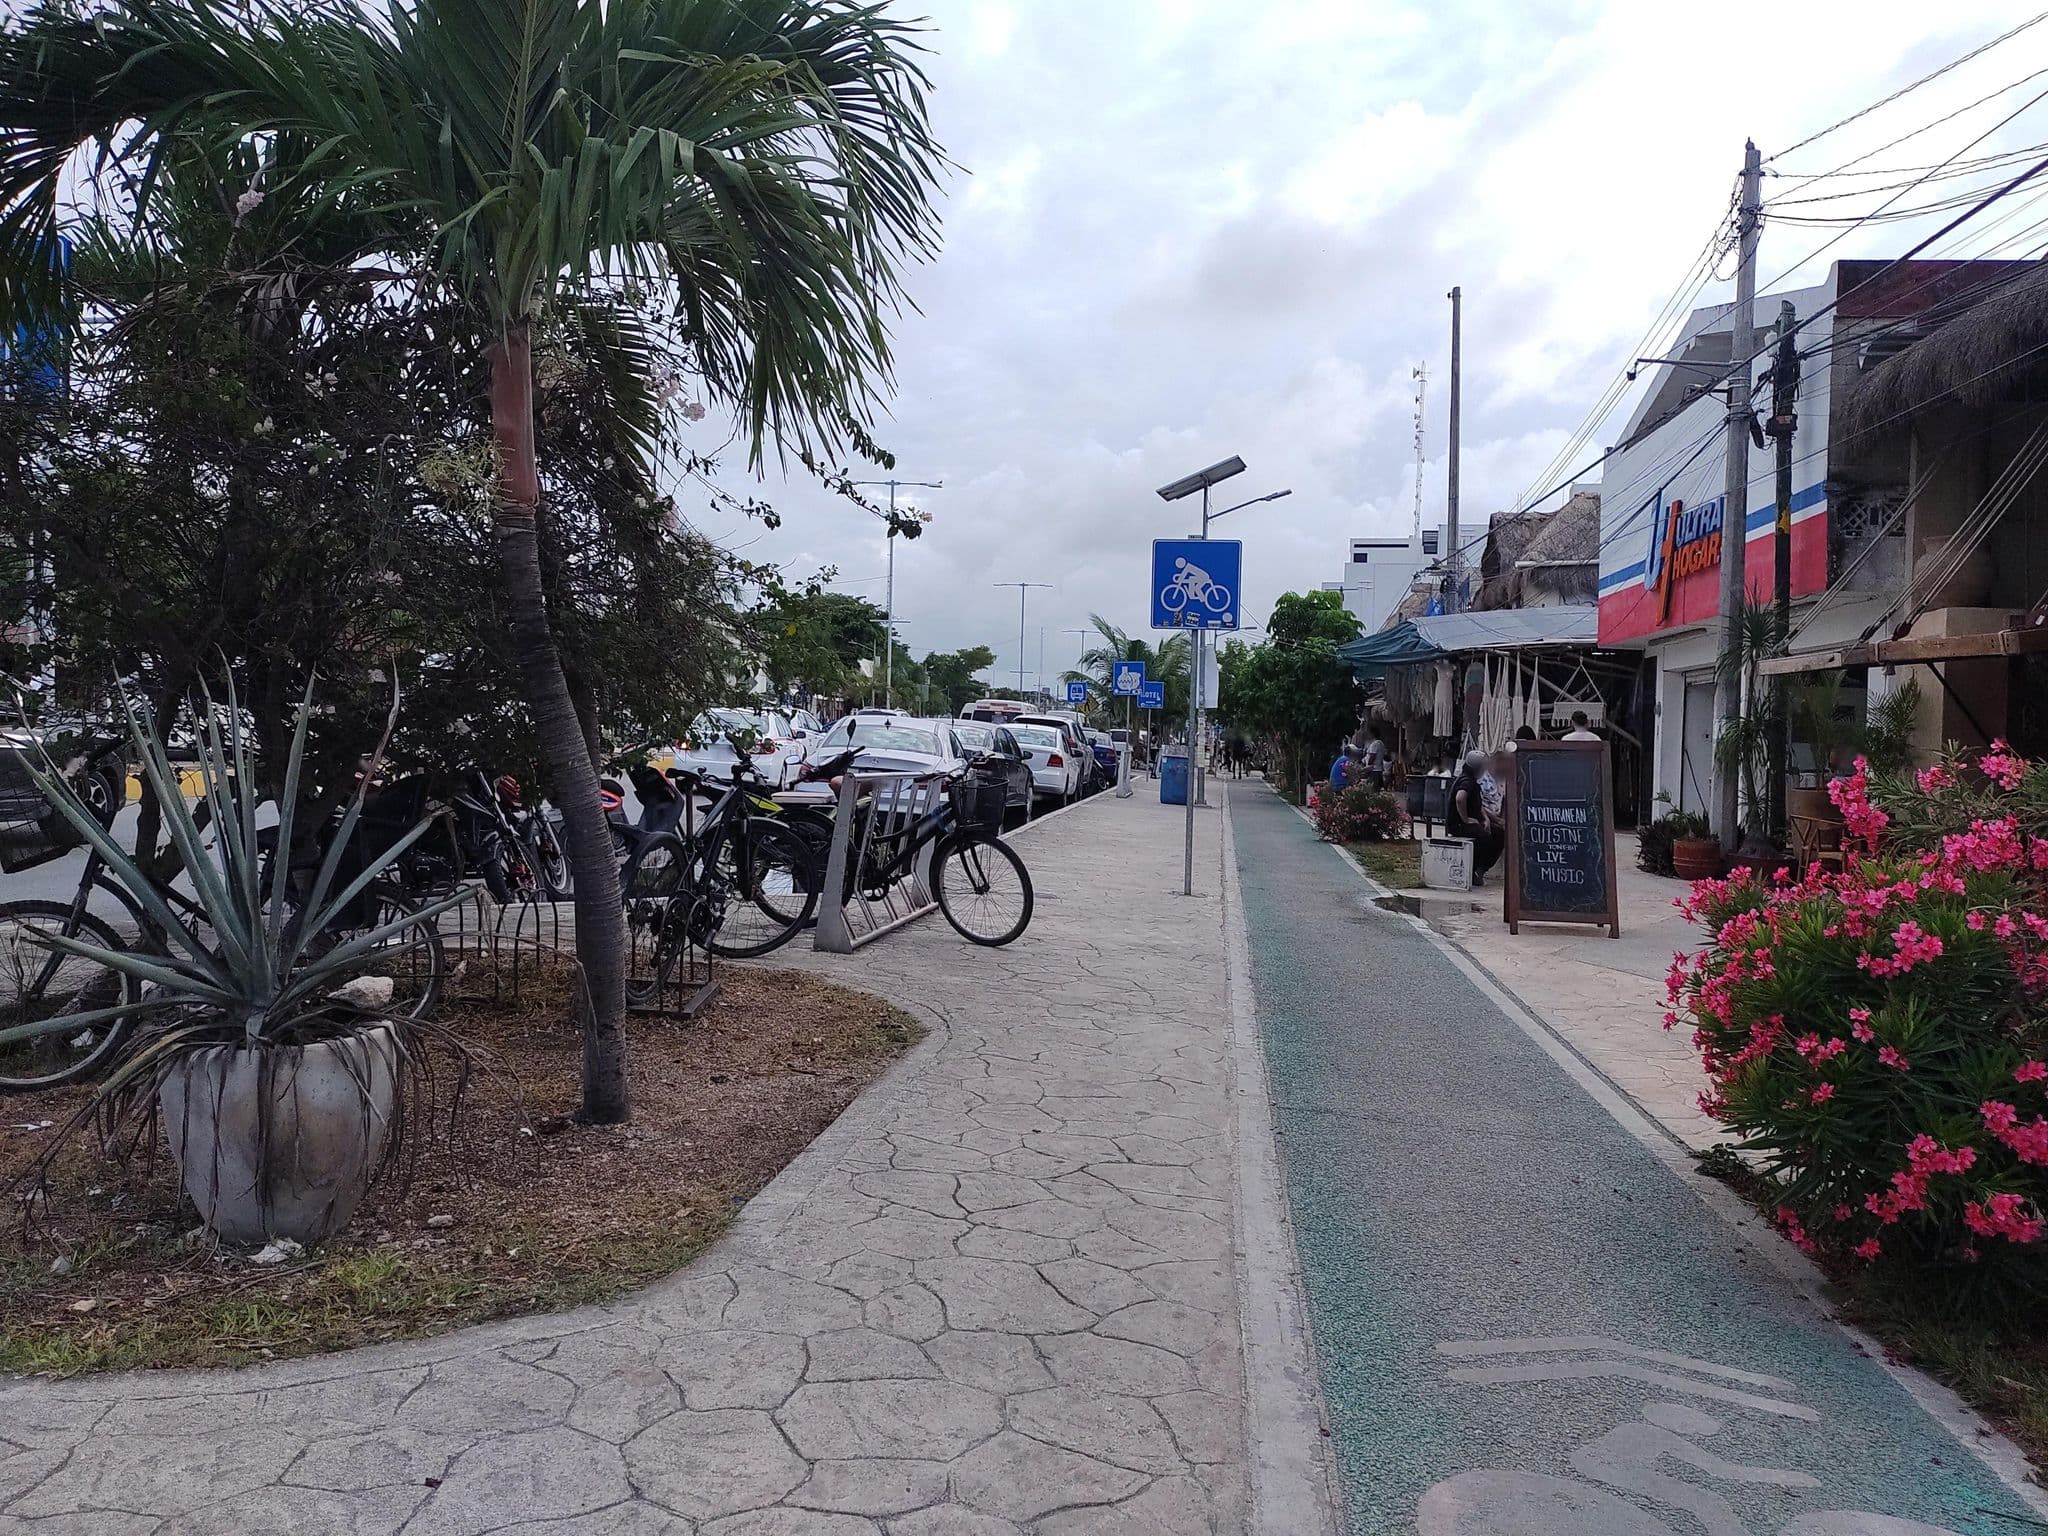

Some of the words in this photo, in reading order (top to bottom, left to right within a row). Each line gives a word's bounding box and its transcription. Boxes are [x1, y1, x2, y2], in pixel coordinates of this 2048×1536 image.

[1675, 496, 1724, 548] ULTRA
[1536, 851, 1568, 864] LIVE
[1541, 867, 1584, 885] MUSIC
